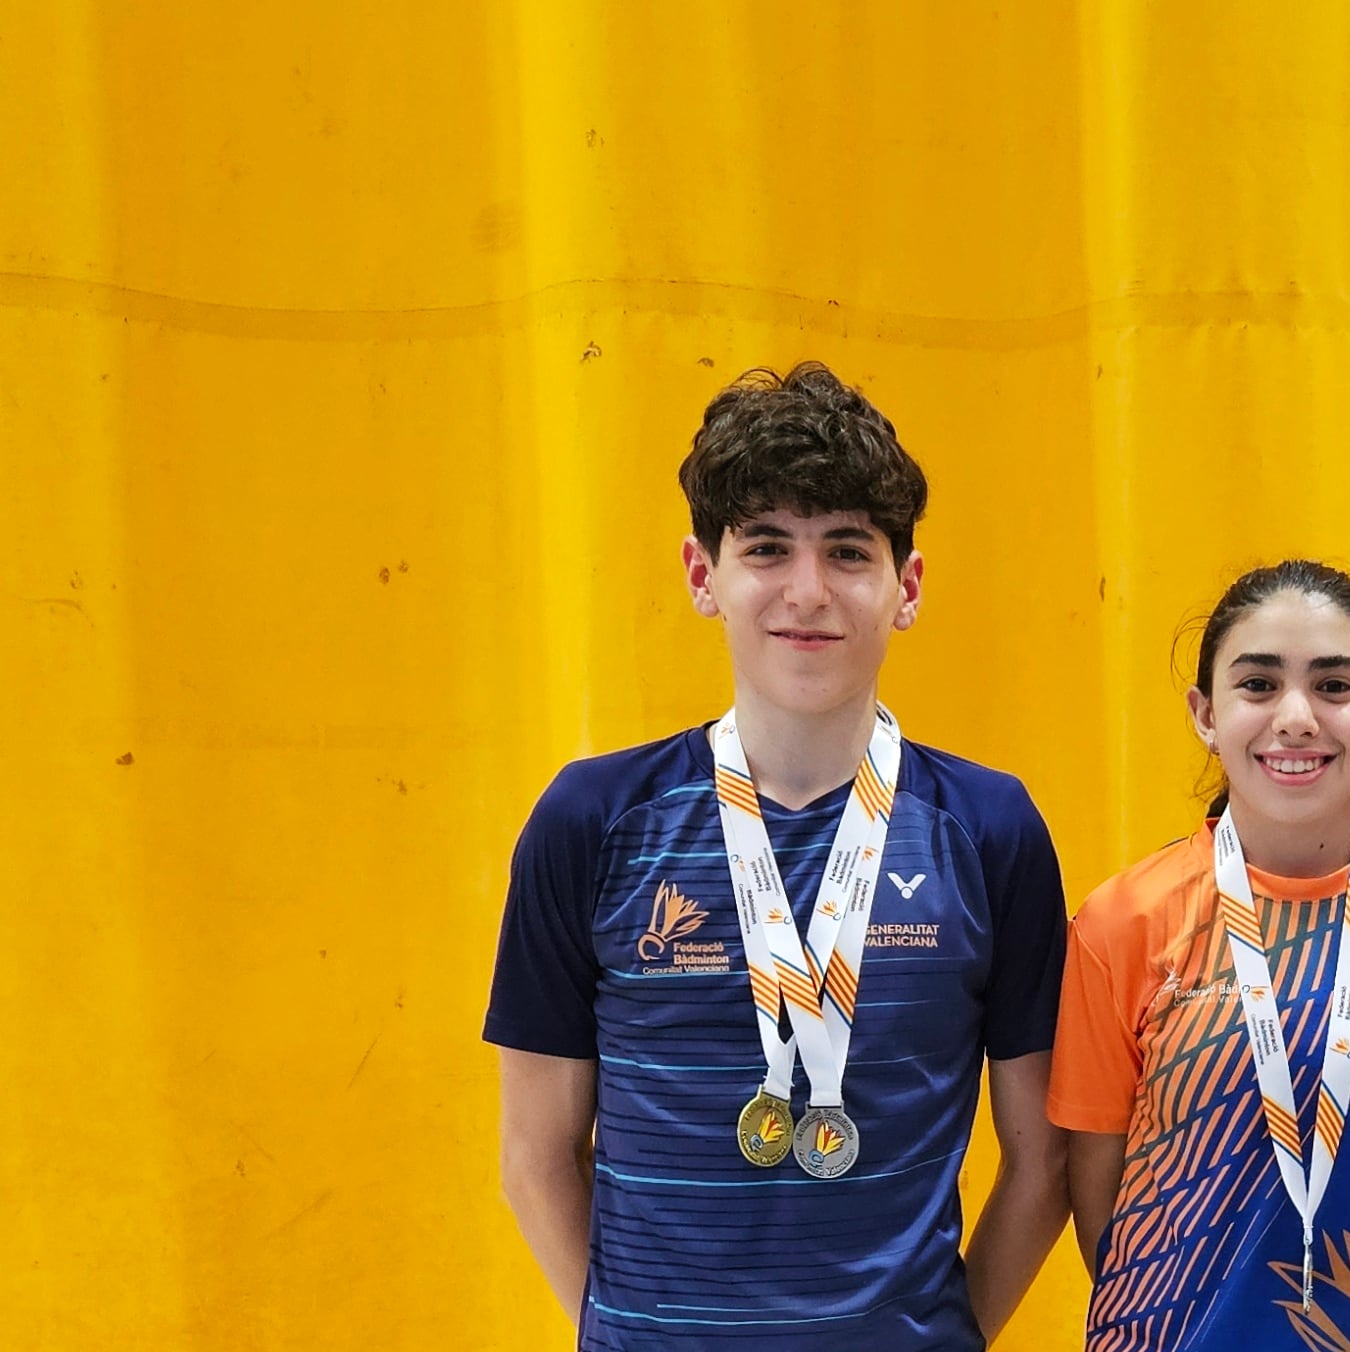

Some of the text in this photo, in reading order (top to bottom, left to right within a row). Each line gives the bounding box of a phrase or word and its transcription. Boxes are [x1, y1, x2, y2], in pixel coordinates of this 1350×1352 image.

[673, 941, 724, 953] Federació
[673, 954, 729, 965] Bàdminton
[643, 965, 682, 975] Comunitat
